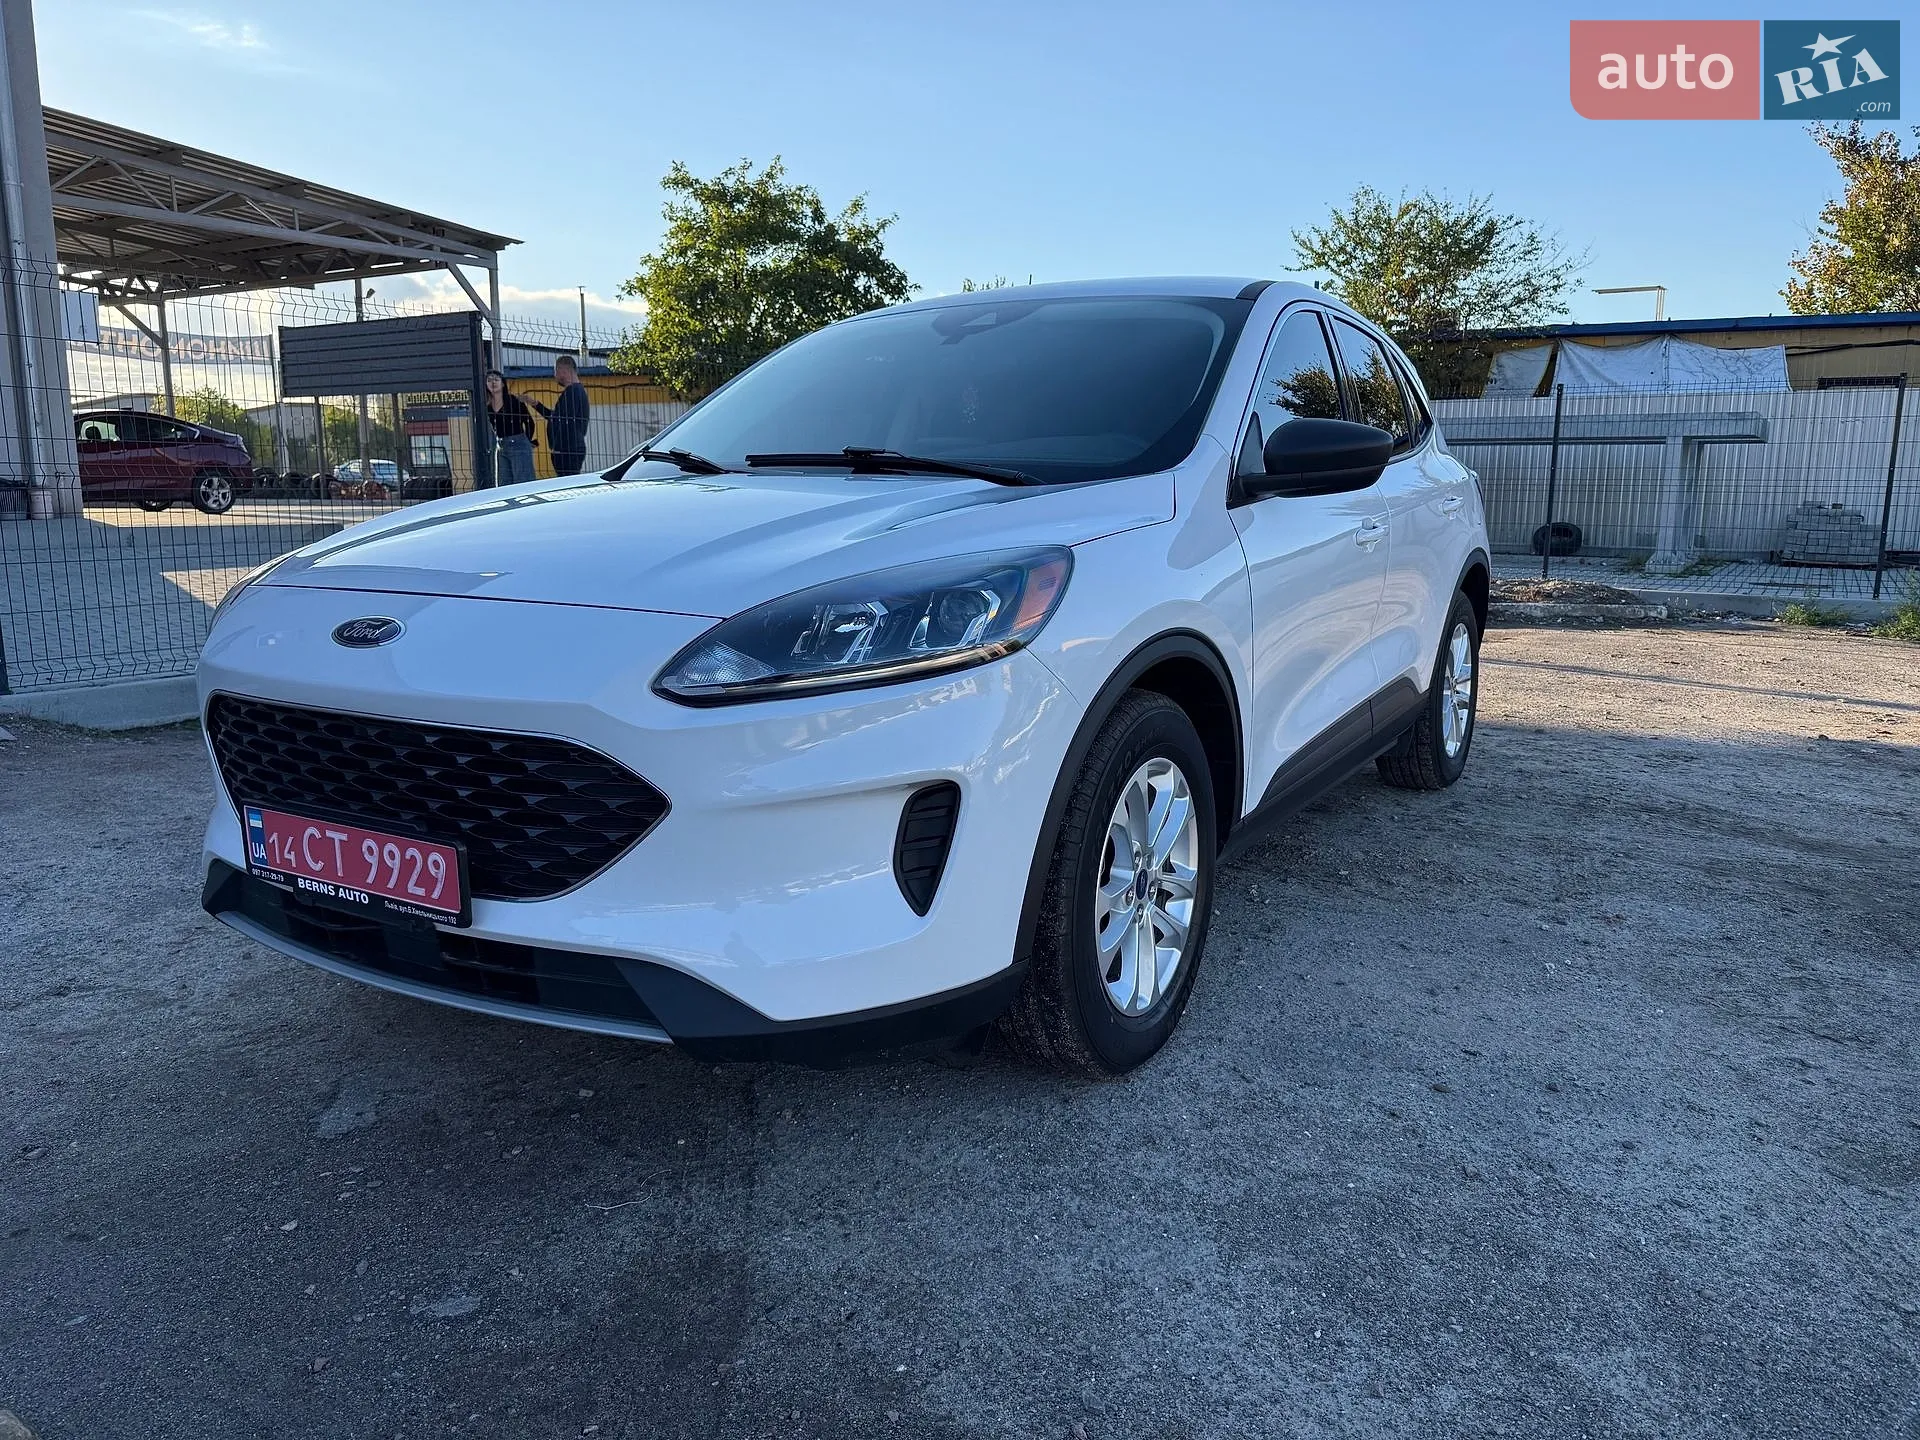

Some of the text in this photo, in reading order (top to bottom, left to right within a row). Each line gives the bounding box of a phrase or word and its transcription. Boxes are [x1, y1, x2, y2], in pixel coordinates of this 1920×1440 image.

[343, 619, 387, 639] Ford
[252, 841, 267, 860] UA
[361, 838, 446, 900] 9929
[297, 877, 369, 904] BERNS AUTO
